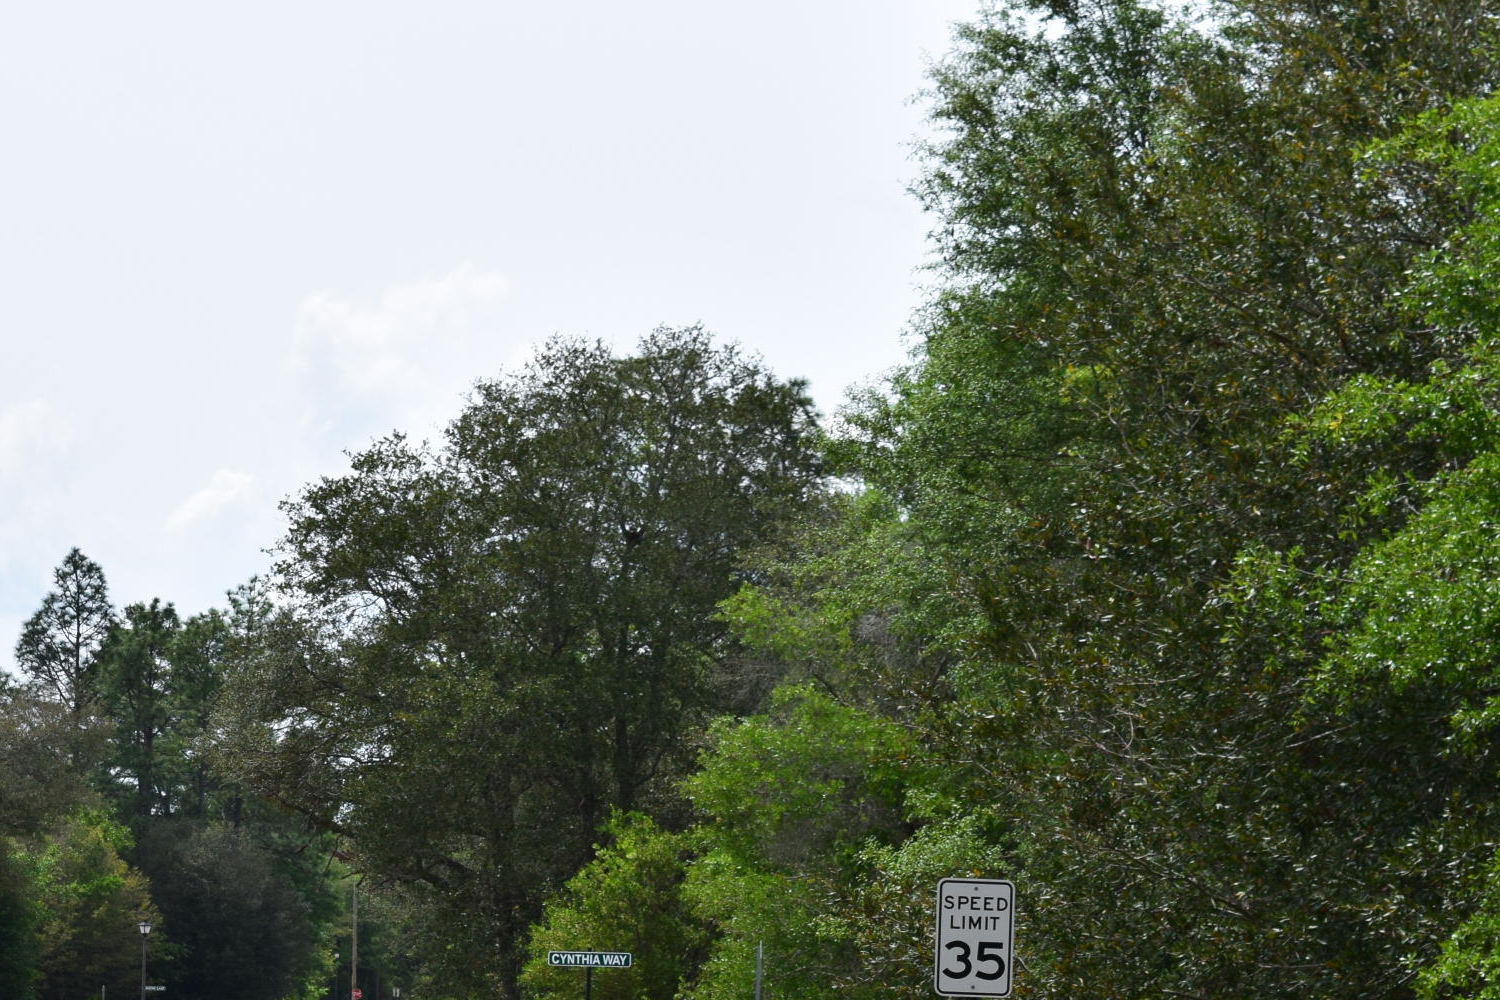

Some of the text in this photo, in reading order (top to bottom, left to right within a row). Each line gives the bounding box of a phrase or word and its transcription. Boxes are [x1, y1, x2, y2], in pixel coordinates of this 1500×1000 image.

[944, 895, 1008, 911] SPEED
[950, 915, 1000, 931] LIMIT
[551, 953, 627, 966] CYNTHIA WAY
[942, 940, 1005, 980] 35
